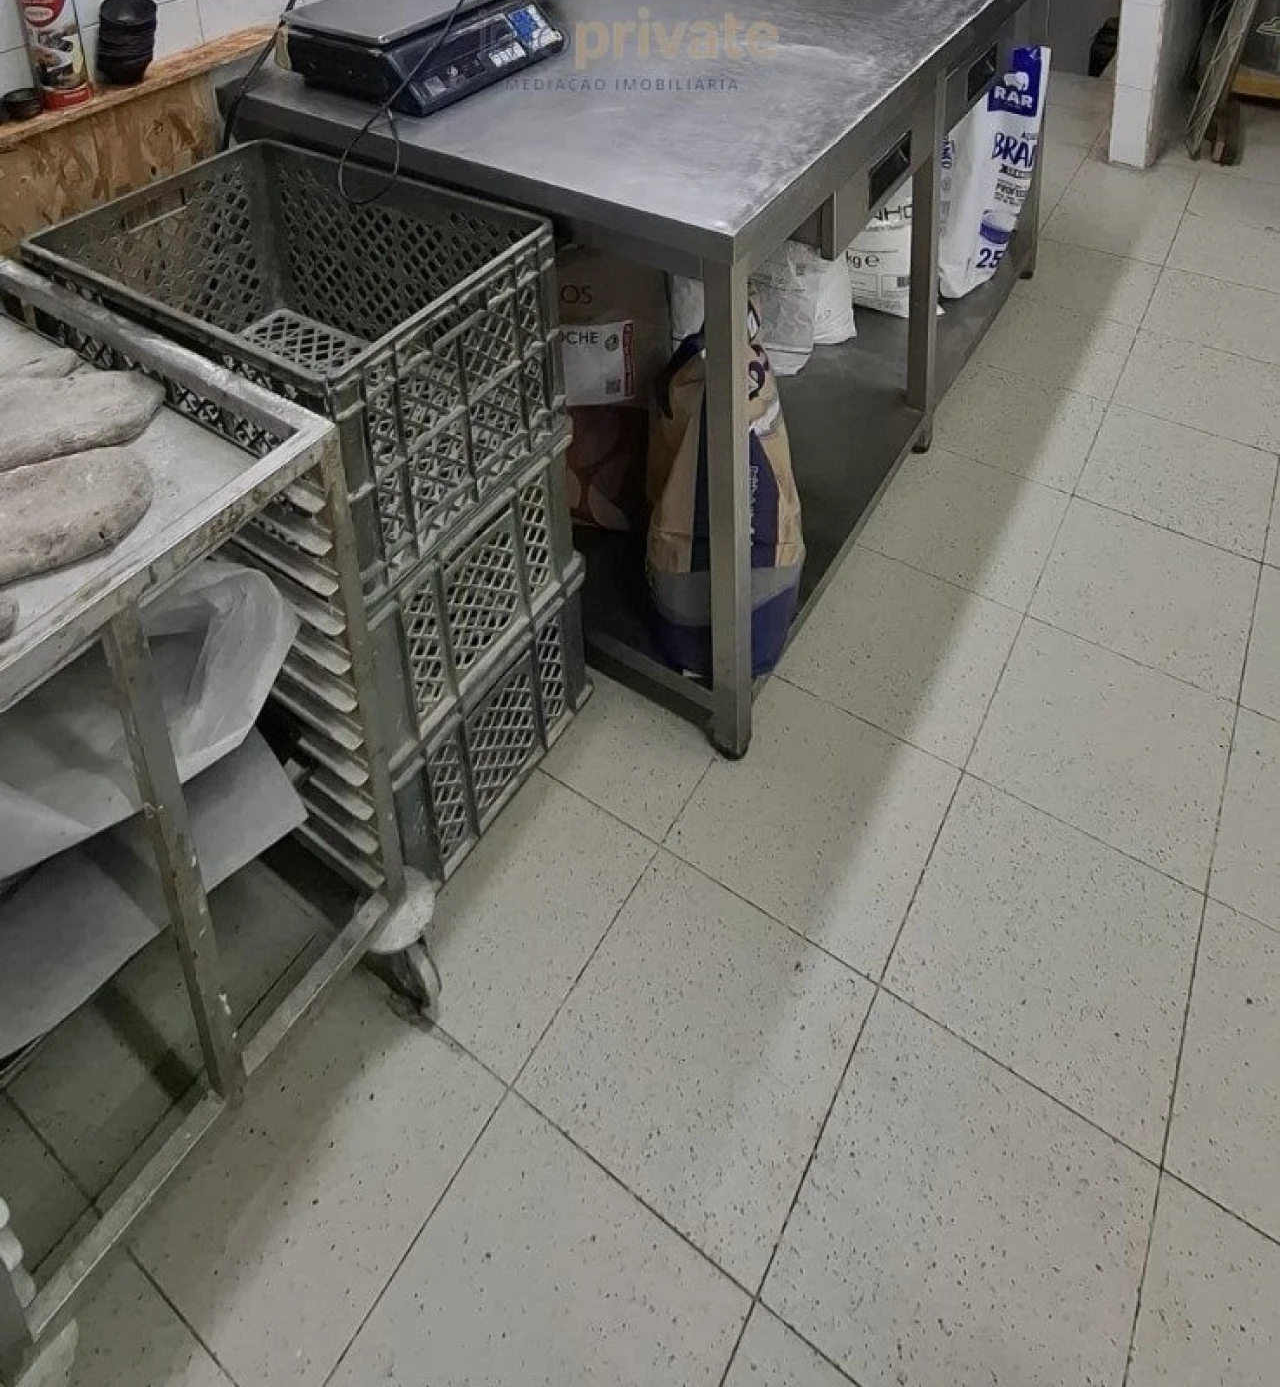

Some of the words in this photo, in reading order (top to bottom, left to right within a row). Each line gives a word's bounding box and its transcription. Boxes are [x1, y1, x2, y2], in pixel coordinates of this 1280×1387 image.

[993, 86, 1033, 108] RAR
[977, 248, 1003, 268] 25
[561, 330, 599, 345] CHE
